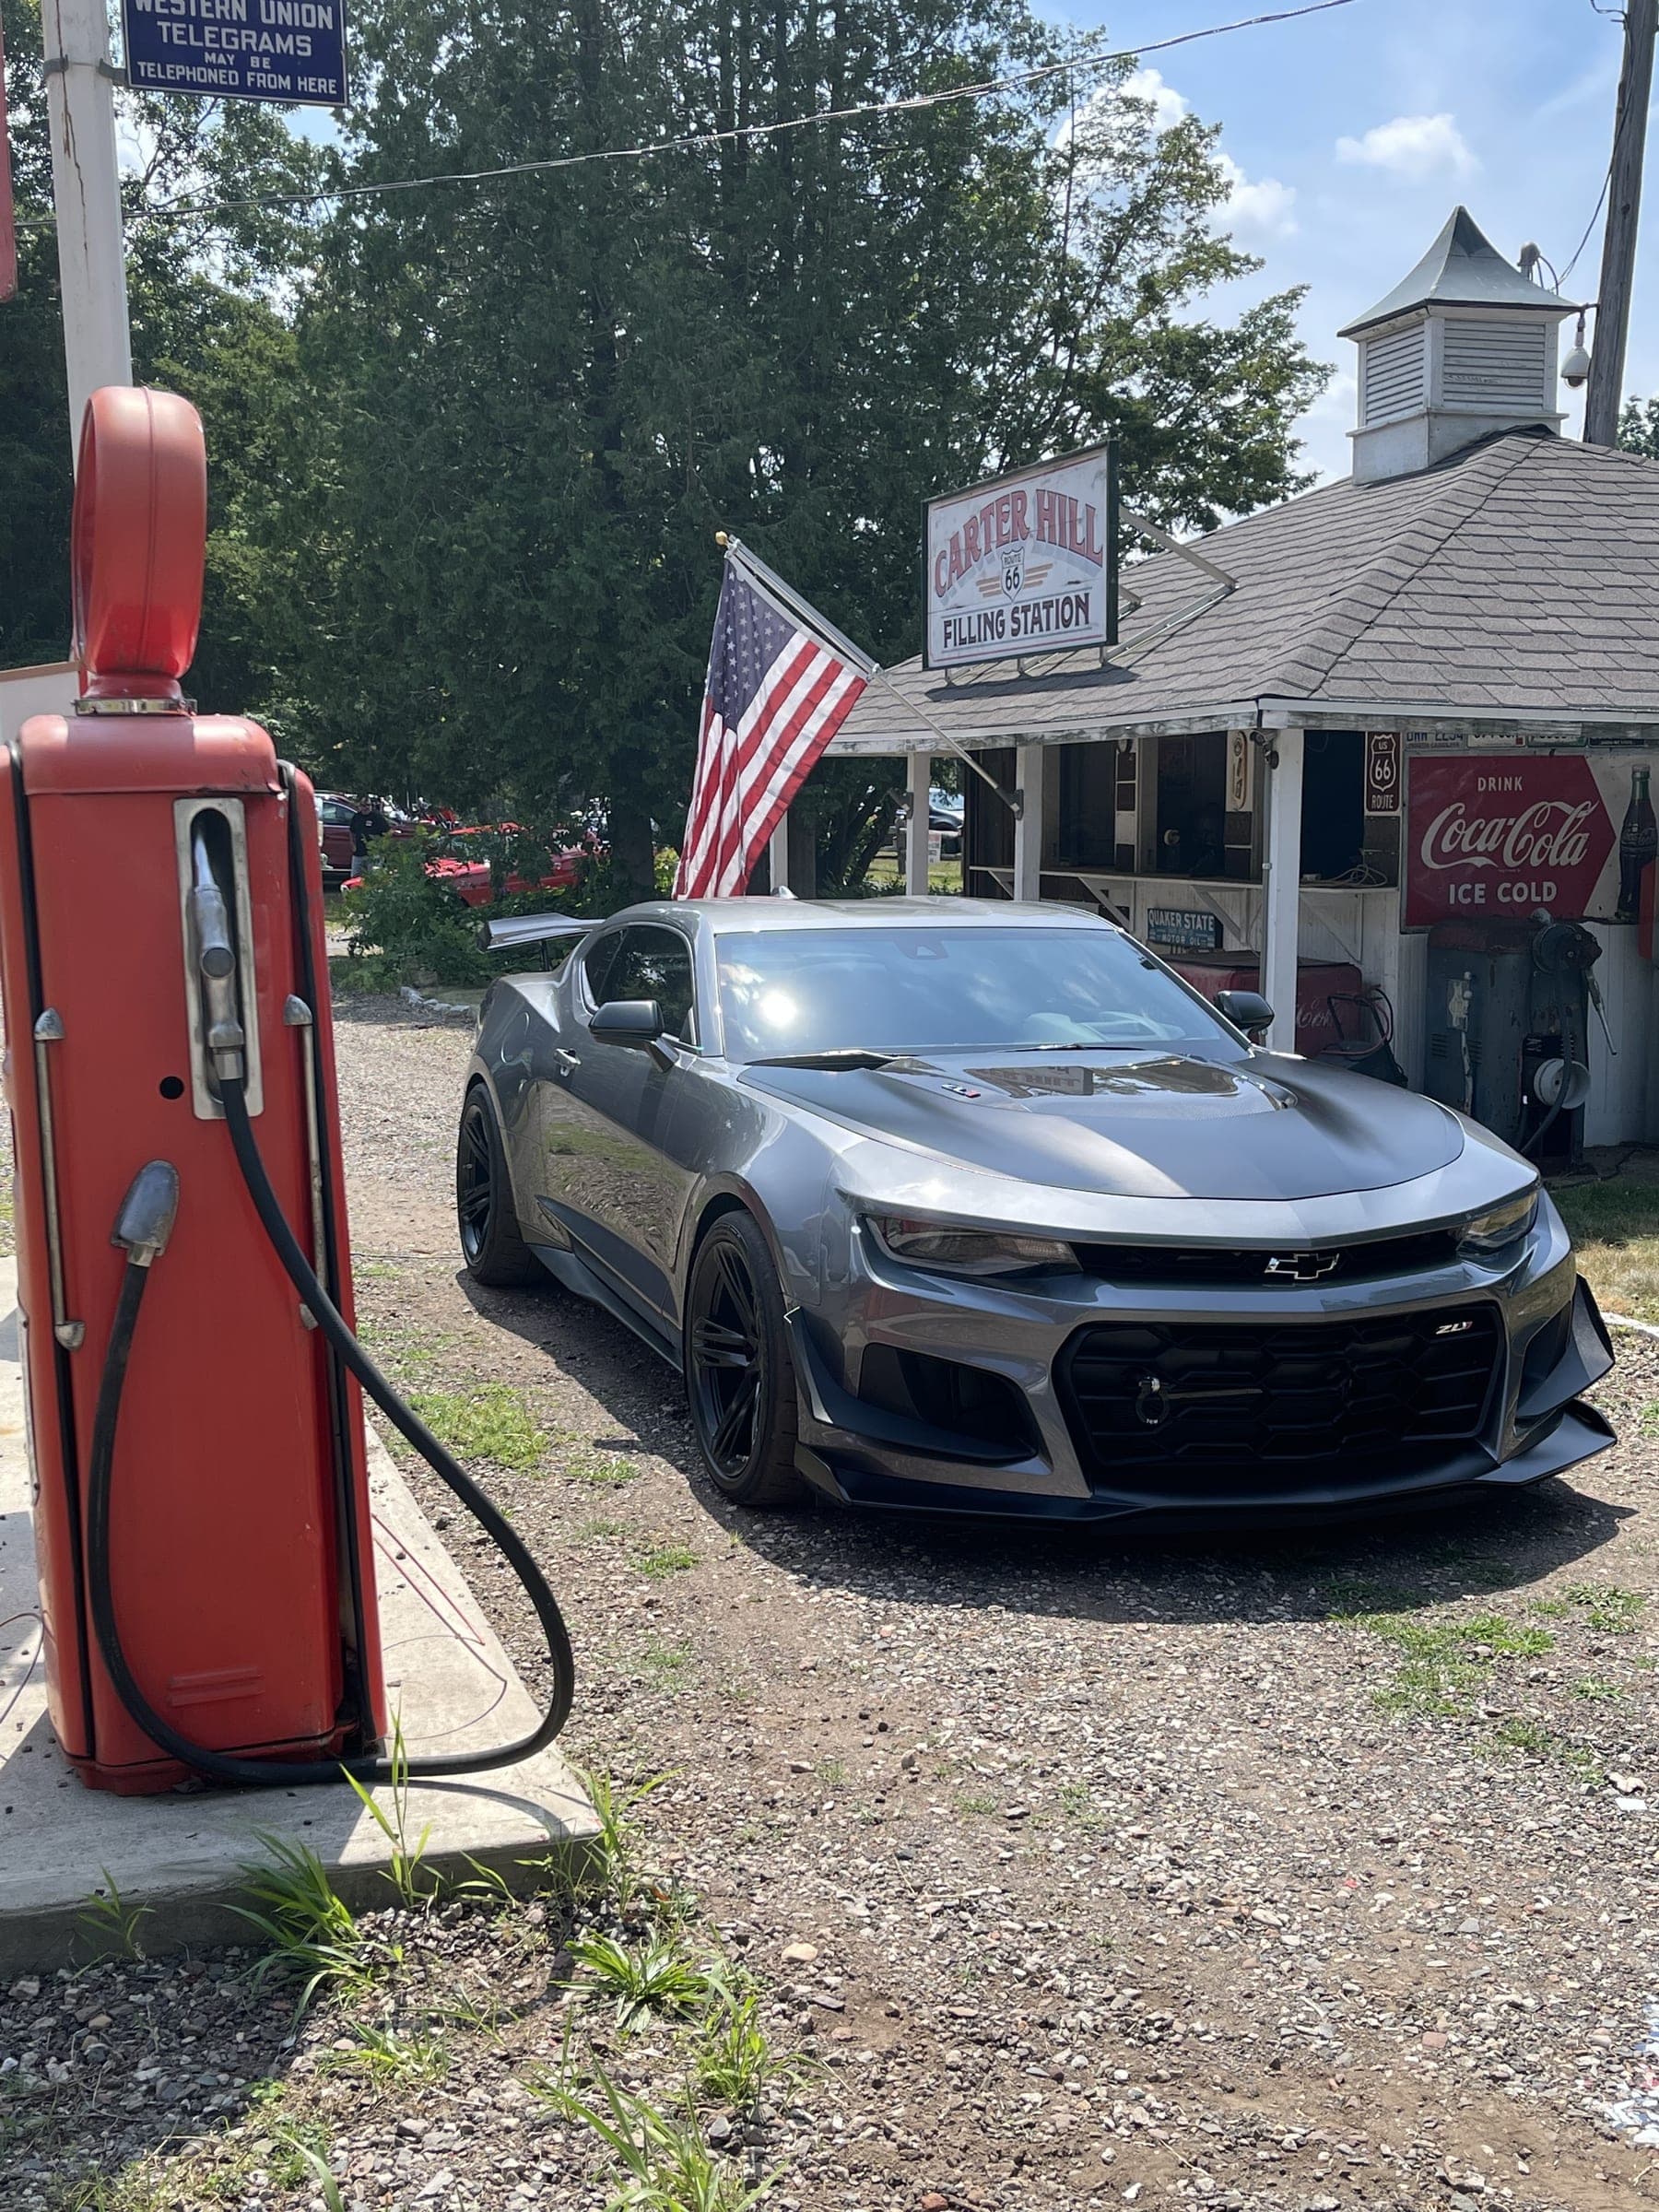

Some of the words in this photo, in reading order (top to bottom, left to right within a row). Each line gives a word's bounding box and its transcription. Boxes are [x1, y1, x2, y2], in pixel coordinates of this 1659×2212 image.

[260, 0, 333, 29] UNION
[157, 20, 312, 57] TELEGRAMS
[205, 52, 235, 65] MAY
[251, 56, 271, 70] BE
[137, 62, 239, 87] TELEPHONED
[247, 71, 291, 90] FROM
[298, 76, 337, 94] HERE
[935, 489, 1030, 598] CARTER
[1036, 488, 1104, 568] HILL
[1005, 566, 1020, 591] 66
[943, 608, 1006, 649] FILLING
[1010, 592, 1090, 637] STATION
[1378, 741, 1388, 750] US
[1375, 759, 1391, 781] 66
[1477, 776, 1523, 792] DRINK
[1371, 794, 1394, 809] ROUTE
[1421, 800, 1600, 870] Coca-Cola
[1449, 884, 1486, 904] ICE
[1497, 881, 1557, 902] COLD
[1148, 909, 1182, 927] QUAKER
[1183, 913, 1215, 931] STATE
[1161, 934, 1185, 945] MOTOR
[1189, 936, 1200, 947] OIL
